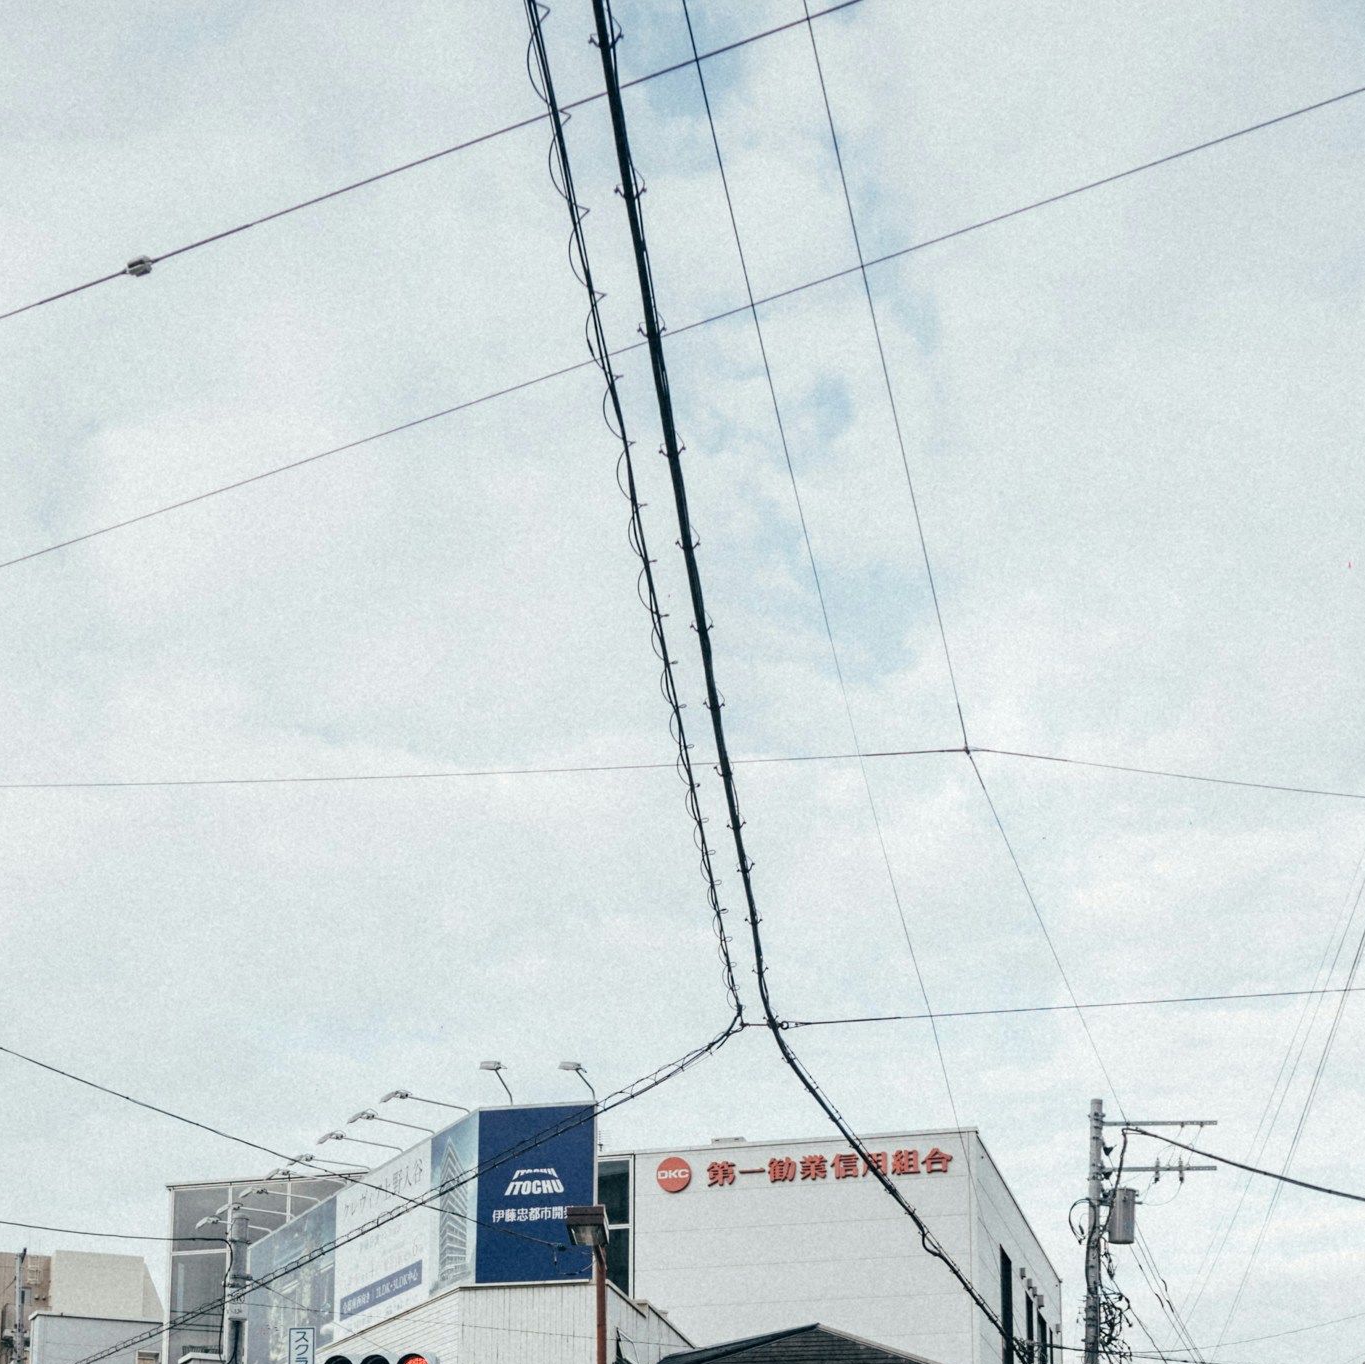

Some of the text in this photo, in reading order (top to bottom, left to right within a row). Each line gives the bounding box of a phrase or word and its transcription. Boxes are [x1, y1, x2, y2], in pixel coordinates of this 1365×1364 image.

[658, 1168, 690, 1180] DKC
[707, 1147, 952, 1187] 第一勧業信用組合
[504, 1178, 564, 1196] ITOCHU
[492, 1205, 574, 1223] 伊藤忠都市開
